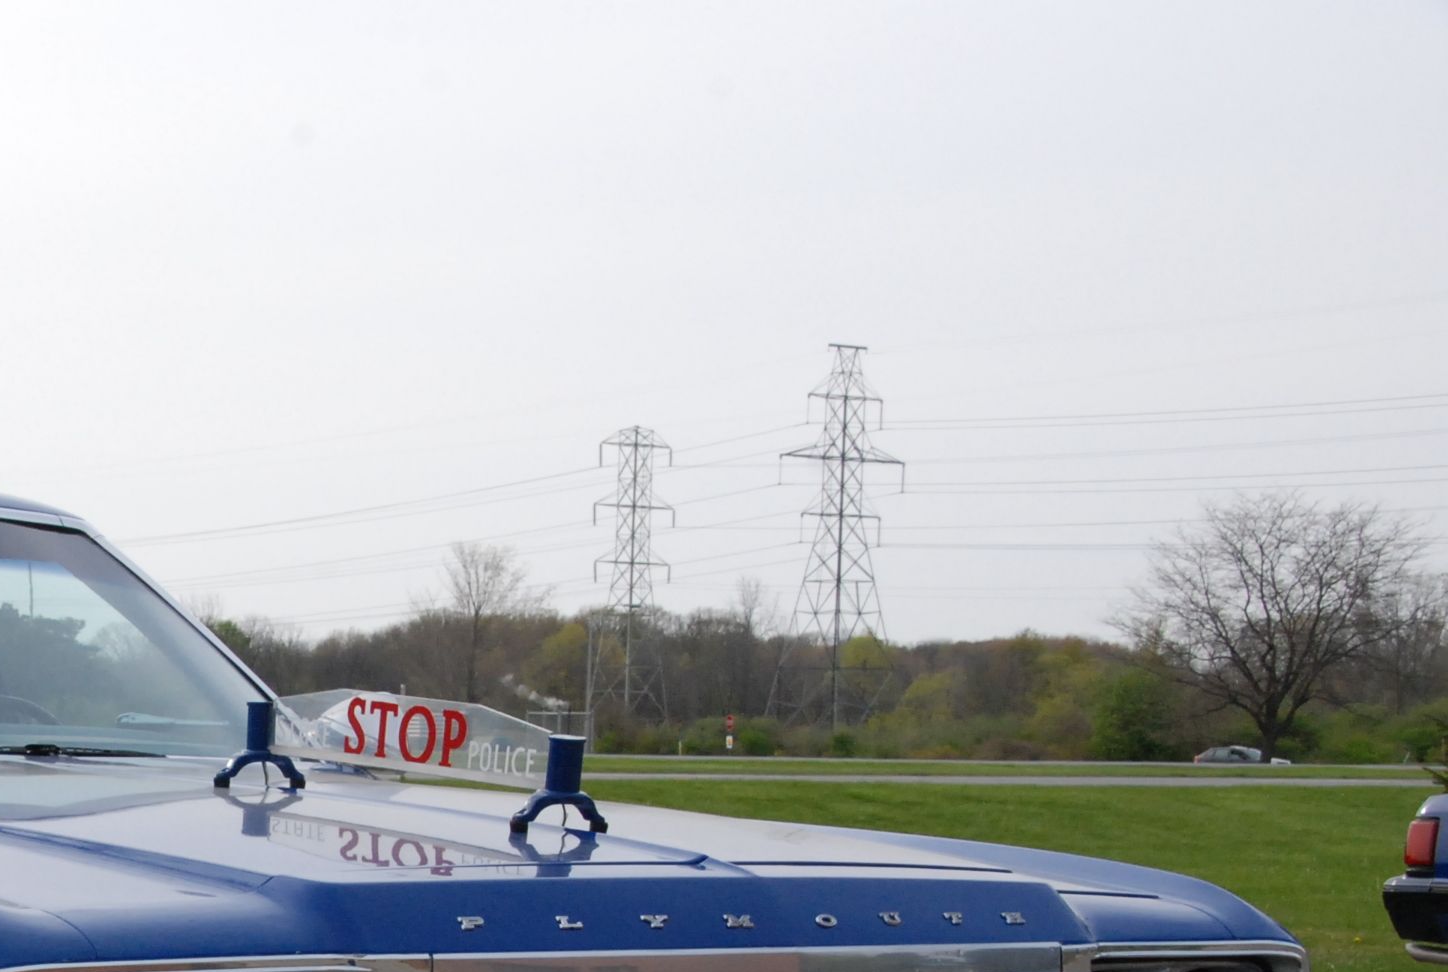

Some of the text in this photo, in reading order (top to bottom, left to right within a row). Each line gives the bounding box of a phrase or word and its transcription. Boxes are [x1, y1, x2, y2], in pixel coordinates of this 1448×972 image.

[343, 697, 468, 768] STOP
[467, 739, 537, 778] POLICE
[456, 910, 1027, 932] PLYMOUTH
